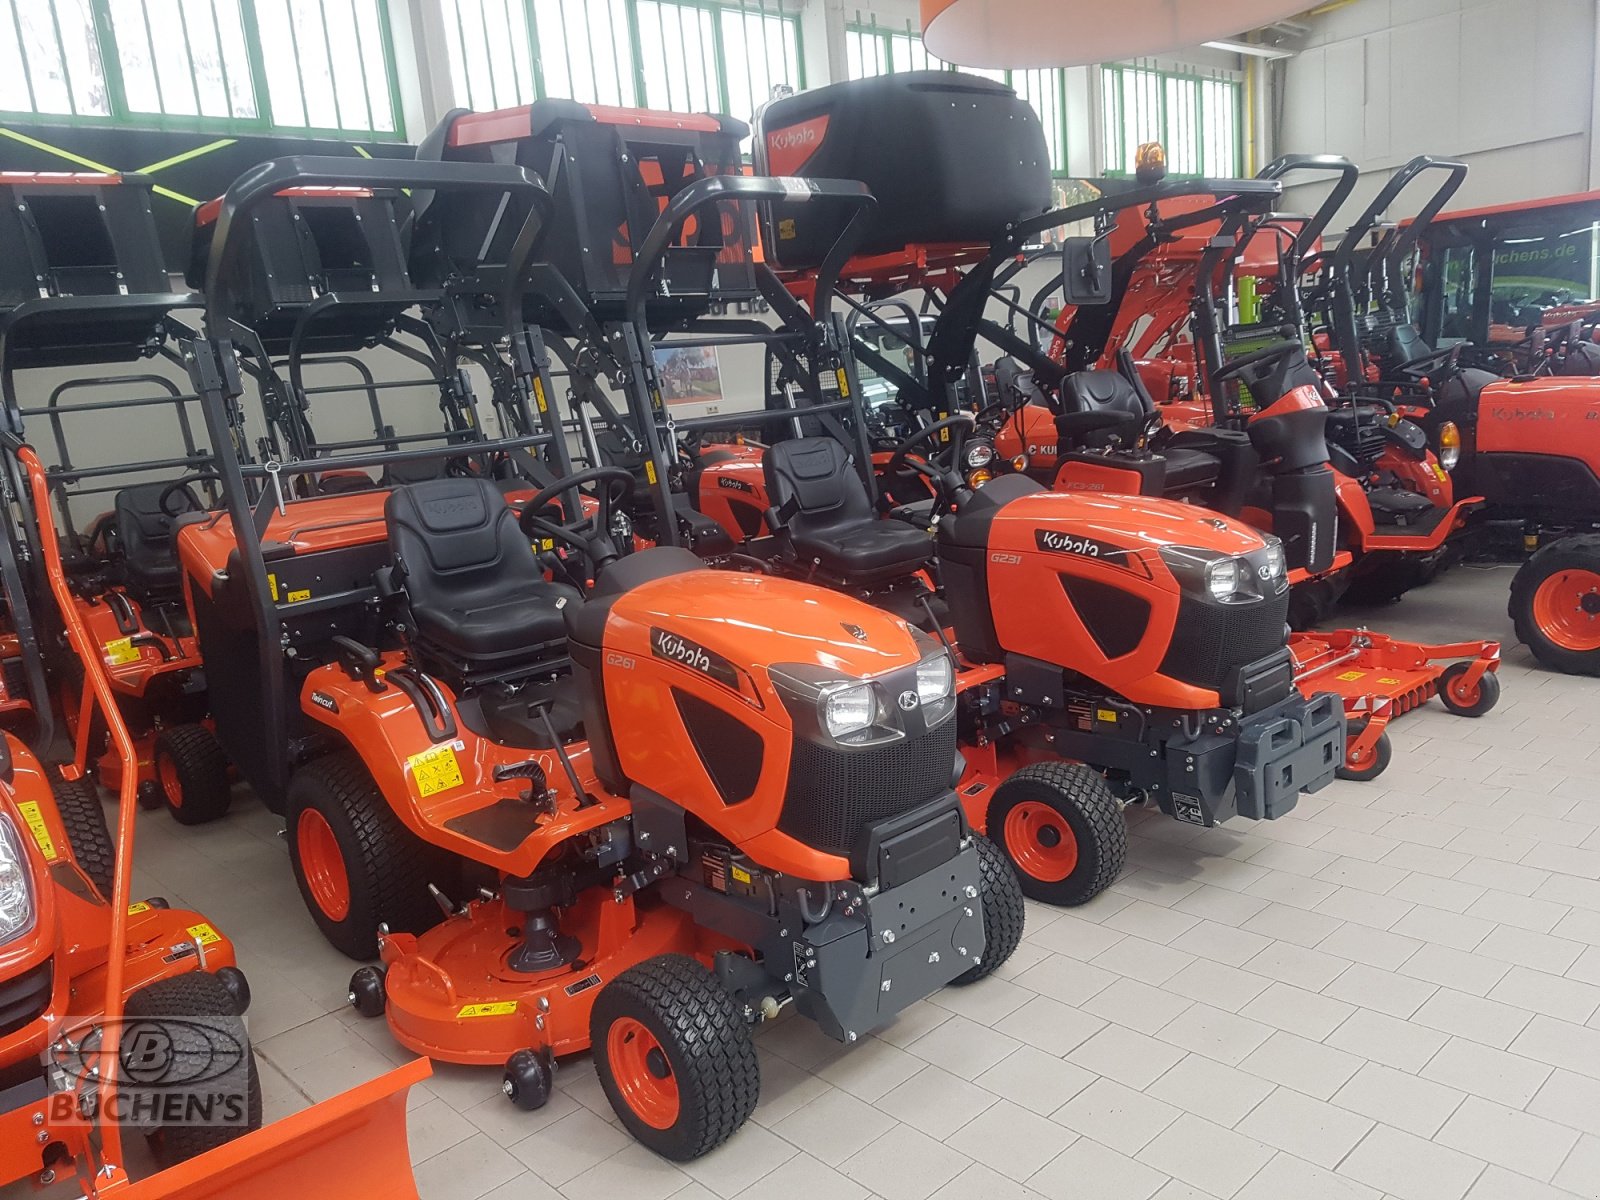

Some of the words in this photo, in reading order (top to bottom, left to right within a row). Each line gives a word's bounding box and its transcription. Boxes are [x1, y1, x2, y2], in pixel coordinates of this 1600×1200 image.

[771, 127, 815, 150] Kubota
[1044, 532, 1099, 557] Kubota
[991, 553, 1022, 565] G231
[606, 653, 636, 670] G261
[658, 632, 710, 671] Kubota
